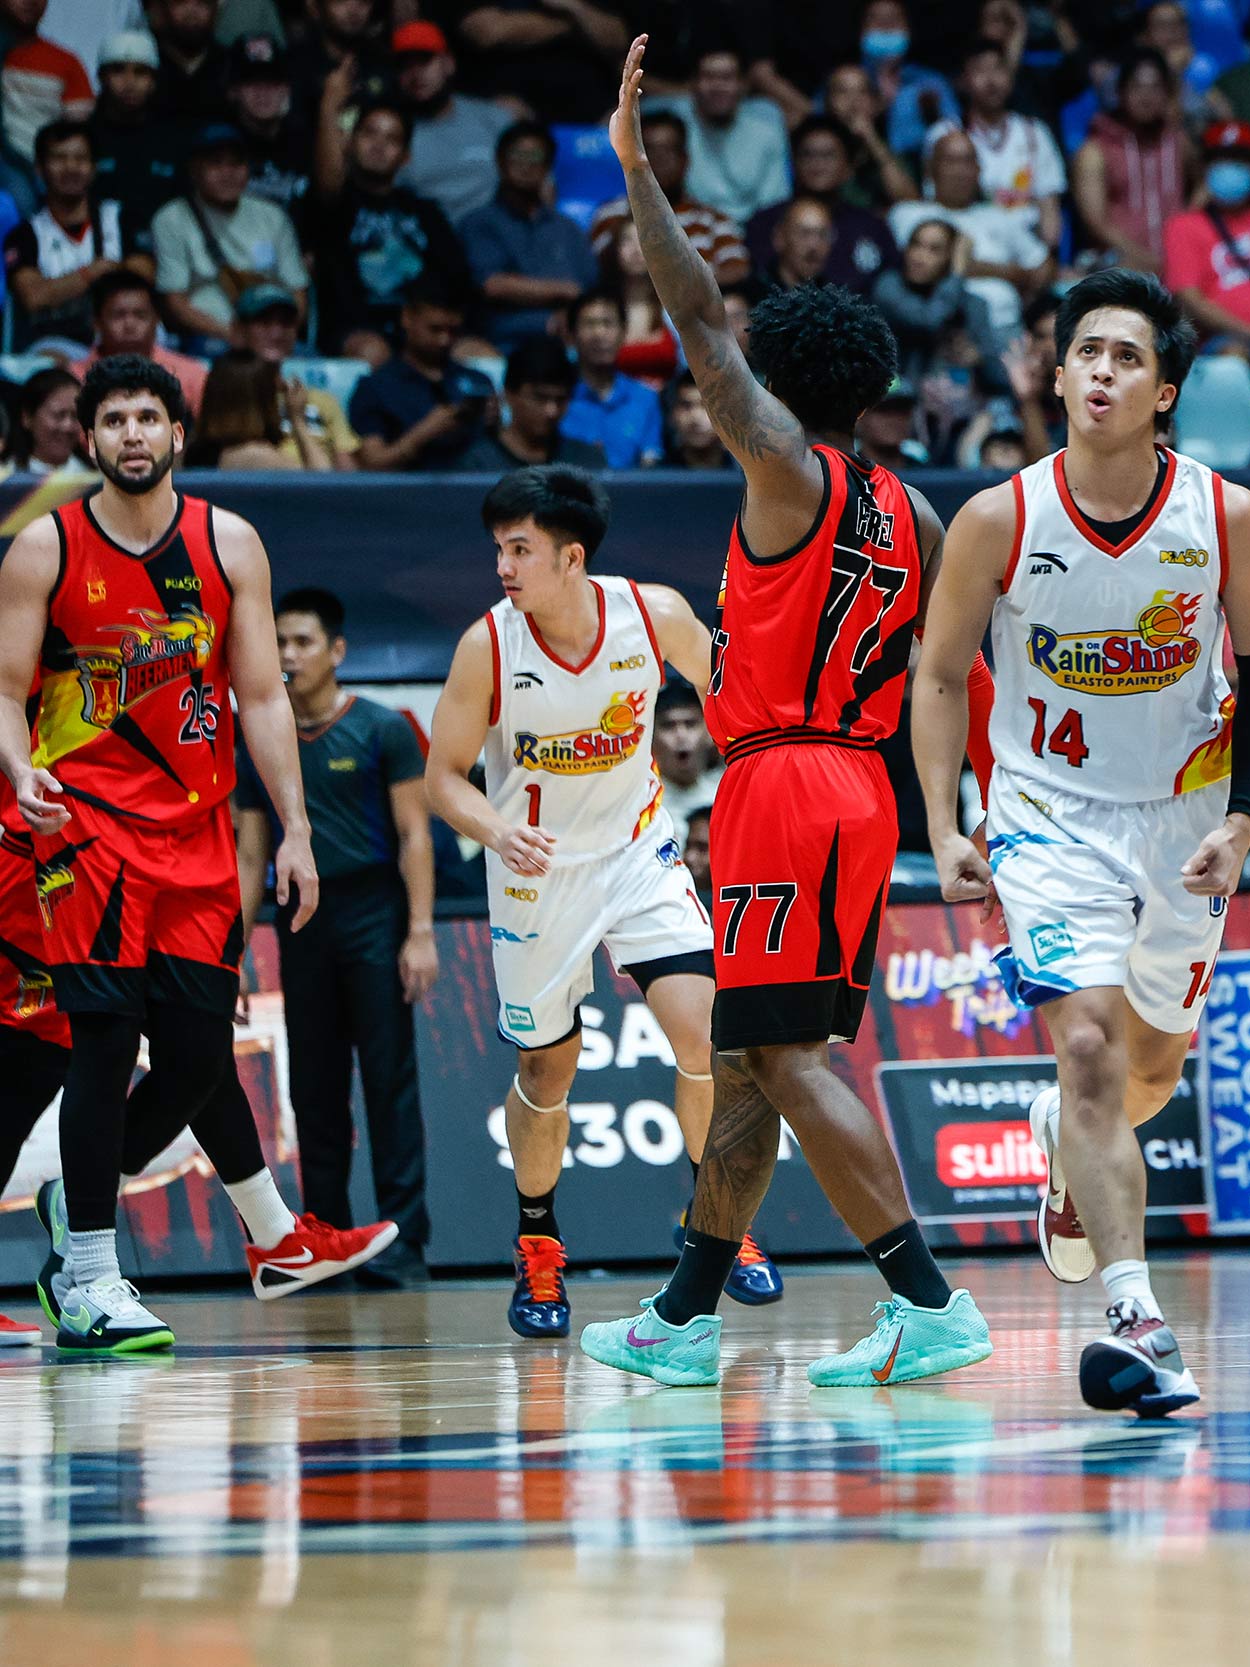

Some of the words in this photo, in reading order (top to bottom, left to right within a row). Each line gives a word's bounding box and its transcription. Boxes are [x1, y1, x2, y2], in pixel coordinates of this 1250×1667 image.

[1030, 564, 1053, 575] ANTA
[828, 543, 909, 674] 77
[1030, 625, 1101, 675] Rain
[1086, 642, 1100, 650] OR
[1101, 636, 1199, 676] Shine
[126, 652, 198, 701] BEERMEN
[1063, 673, 1114, 688] ELASTO
[1117, 672, 1178, 687] PAINTERS
[179, 683, 221, 745] 25
[1027, 696, 1090, 769] 14
[514, 731, 573, 767] Rain
[525, 783, 541, 828] 1
[719, 883, 798, 956] 77
[951, 1130, 1049, 1180] sulit
